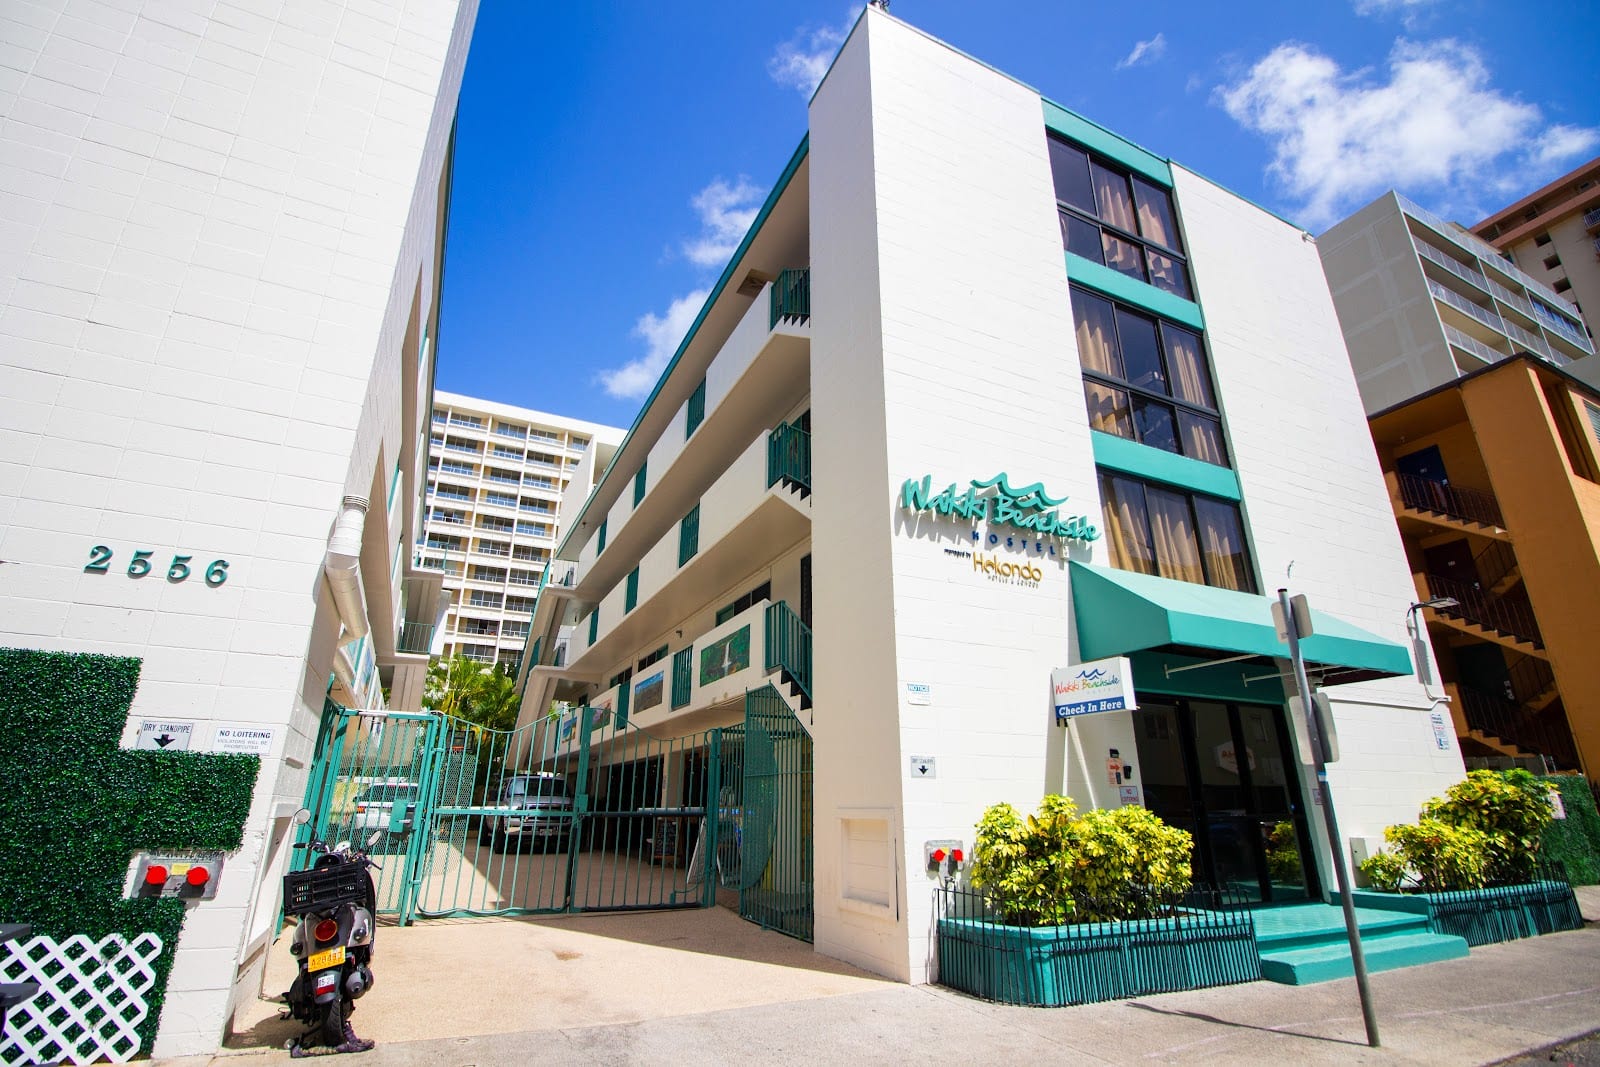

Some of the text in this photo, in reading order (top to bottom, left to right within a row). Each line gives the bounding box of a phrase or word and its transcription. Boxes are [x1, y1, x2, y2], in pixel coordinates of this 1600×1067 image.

[901, 474, 1101, 542] Waikiki Beachside
[971, 530, 1056, 556] HOSTEL
[83, 545, 231, 587] 2556
[1058, 700, 1122, 716] Check In Here
[143, 723, 192, 734] DRY STANDPIPE
[232, 730, 272, 739] LOITERING
